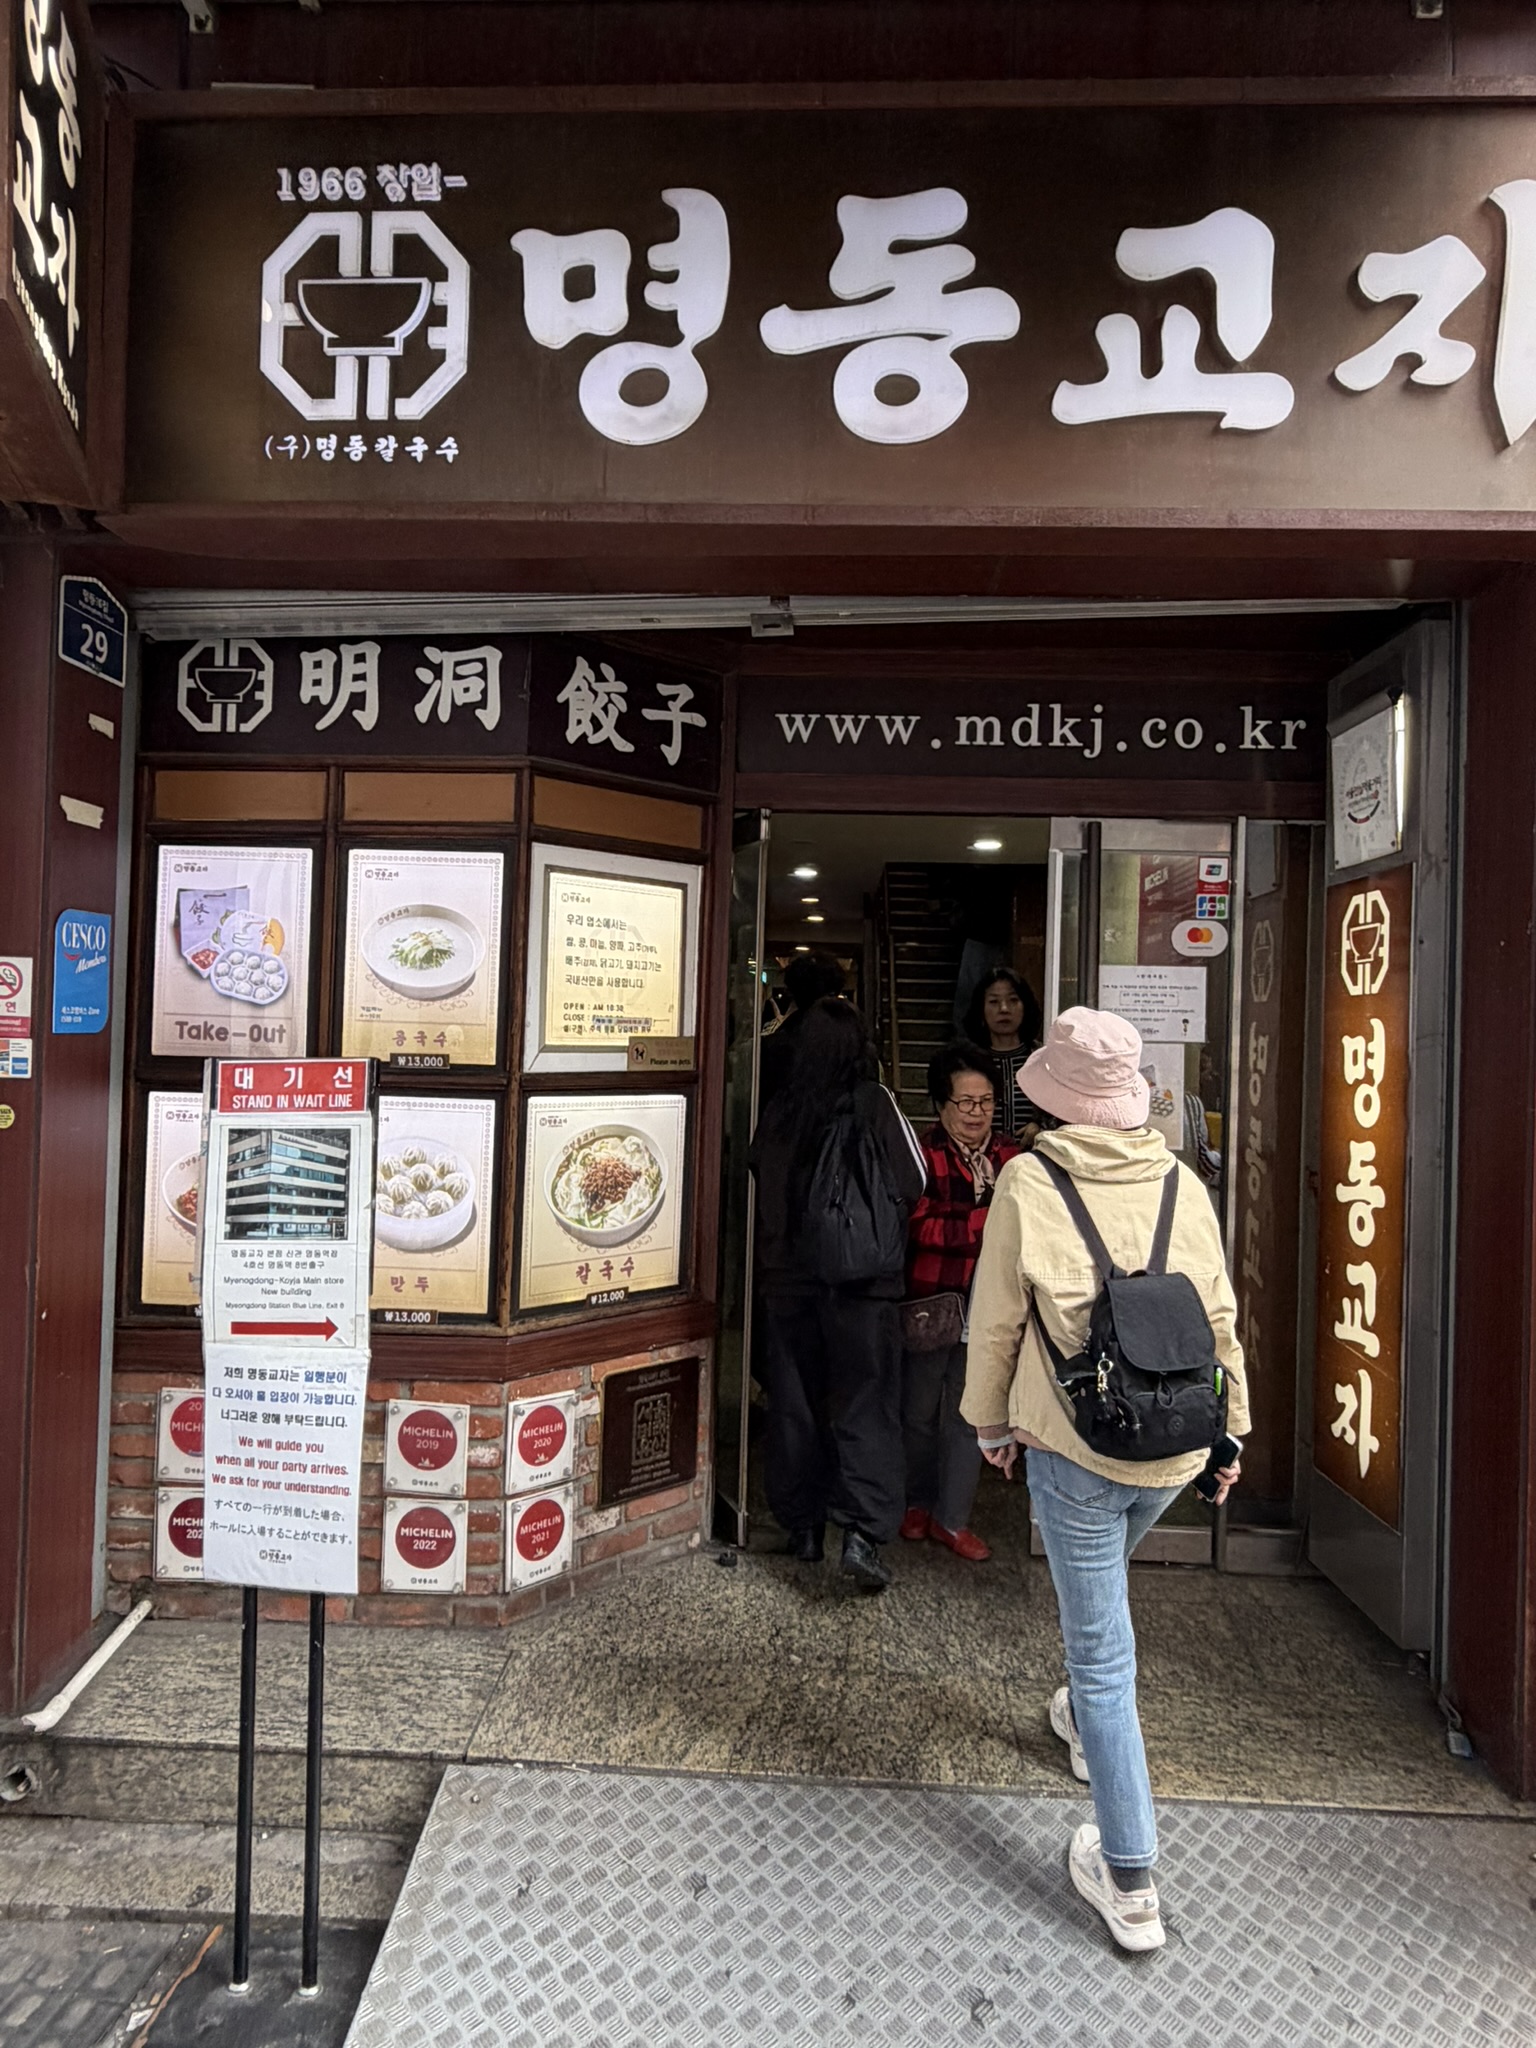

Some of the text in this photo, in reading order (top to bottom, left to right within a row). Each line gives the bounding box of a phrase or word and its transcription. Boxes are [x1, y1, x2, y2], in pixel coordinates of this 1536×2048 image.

[276, 166, 367, 201] 1966
[80, 623, 108, 664] 29
[299, 640, 708, 766] 明洞餃子
[774, 703, 1307, 759] www.mdkj.co.kr
[566, 913, 627, 931] 우리 업소에서는
[61, 921, 106, 951] CESCO
[563, 1002, 585, 1010] OPEN
[563, 1013, 585, 1021] CLOSE
[397, 1055, 443, 1068] ₩13,000
[232, 1093, 353, 1110] STAND IN WAIT LINE
[1330, 1017, 1387, 1479] 명동교자
[574, 1256, 636, 1285] 칼국수
[303, 1276, 322, 1284] Main
[324, 1276, 345, 1285] store
[390, 1274, 430, 1293] 만두
[261, 1288, 312, 1297] New building
[224, 1366, 244, 1379] 저희
[247, 1367, 300, 1382] 명동교자는
[212, 1386, 222, 1398] 다
[269, 1391, 300, 1404] 입장이
[303, 1392, 358, 1406] 가능합니다.
[221, 1408, 258, 1423] 너그러운
[261, 1412, 281, 1425] 양해
[402, 1424, 454, 1440] MICHELIN
[522, 1420, 563, 1439] MICHELIN
[238, 1435, 324, 1454] We will guide you
[416, 1438, 440, 1451] 2019
[532, 1436, 552, 1449] 2020
[215, 1454, 349, 1475] when all your party arrives.
[212, 1473, 352, 1497] We ask for your understanding.
[400, 1526, 454, 1540] MICHELIN
[519, 1514, 562, 1536] MICHELIN
[186, 1528, 204, 1540] 202
[531, 1530, 551, 1545] 2021
[412, 1539, 438, 1551] 2022
